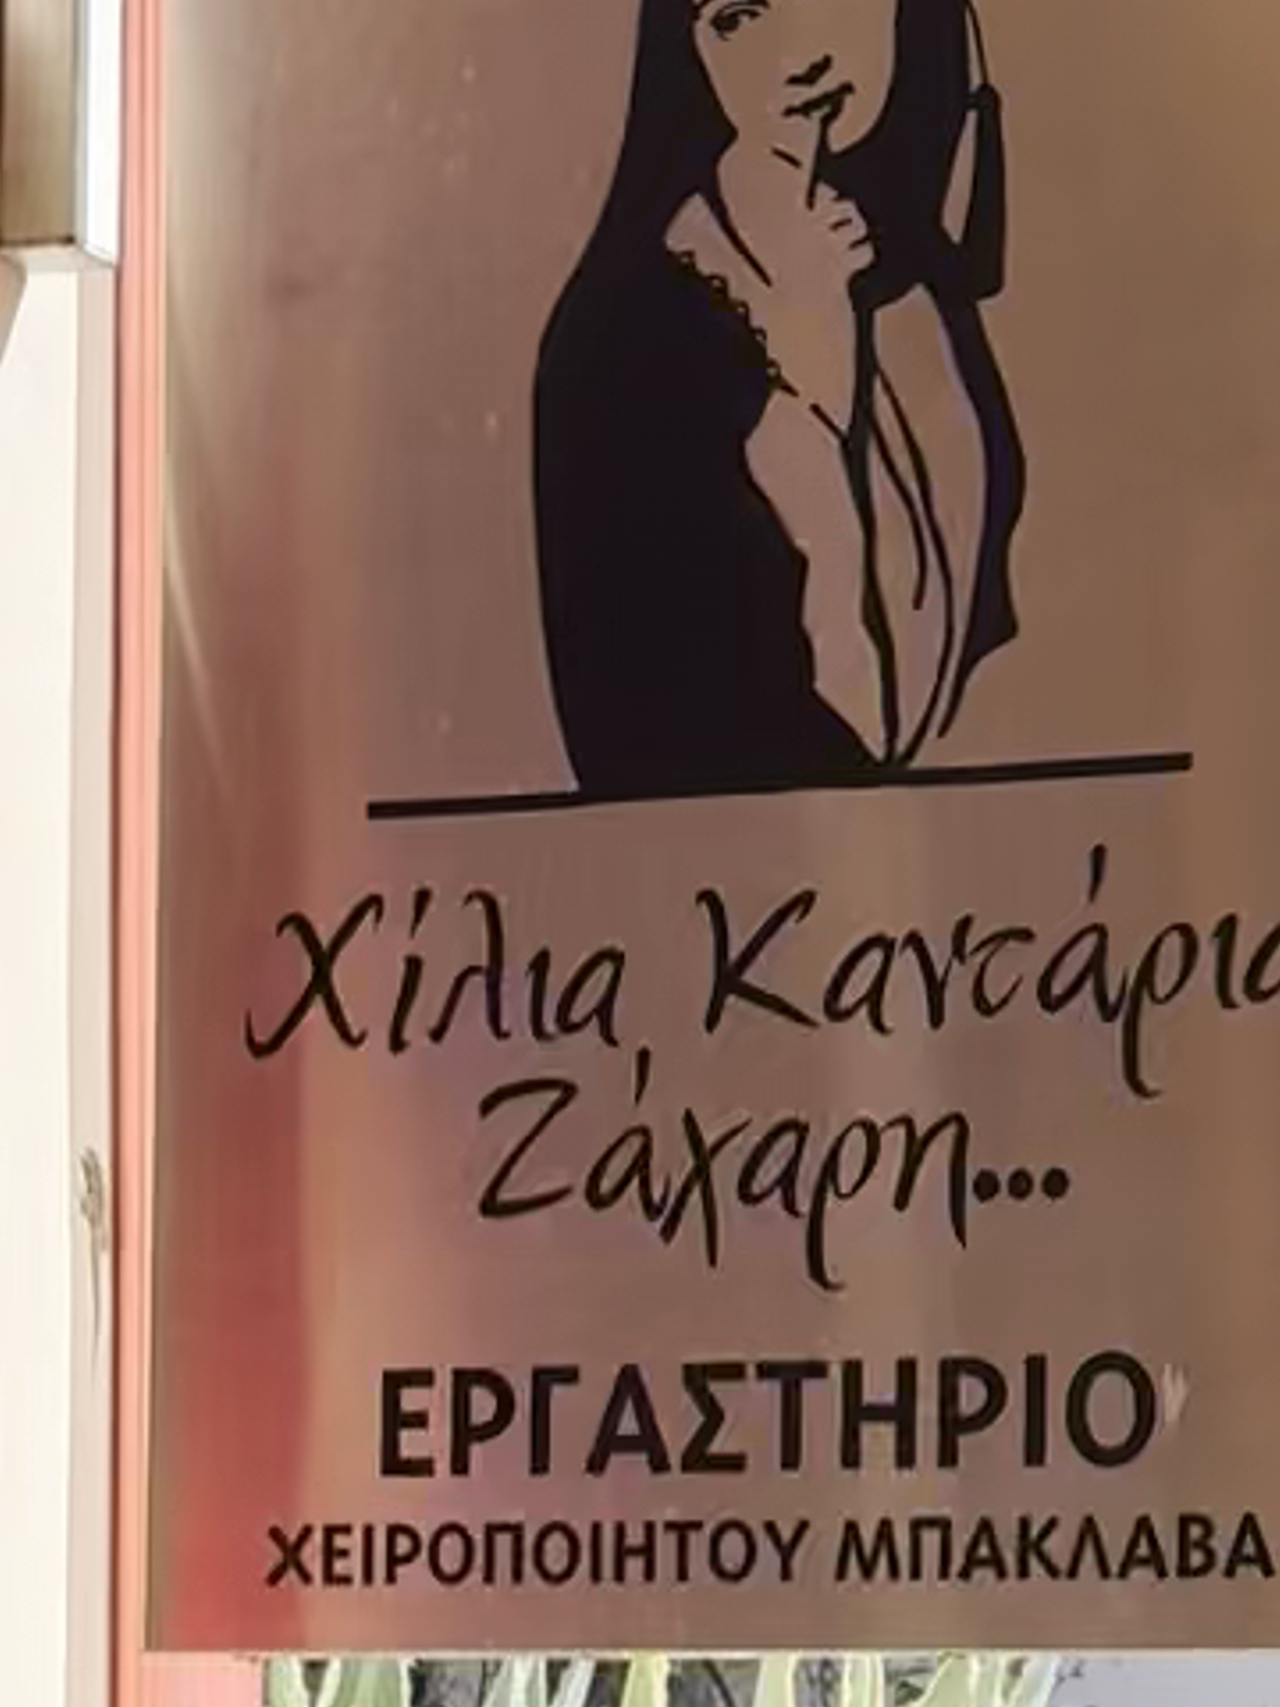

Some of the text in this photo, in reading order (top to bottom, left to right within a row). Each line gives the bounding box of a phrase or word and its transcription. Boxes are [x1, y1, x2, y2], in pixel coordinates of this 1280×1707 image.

[242, 883, 629, 1064] Χίλια
[476, 1044, 1073, 1294] Ζάχαρη...
[378, 1348, 1159, 1479] ΕΡΓΑΣΤΗΡΙΟ
[263, 1509, 1278, 1589] ΧΕΙΡΟΠΟΙΗΤΟΥ ΜΠΑΚΛΑΒΑ
